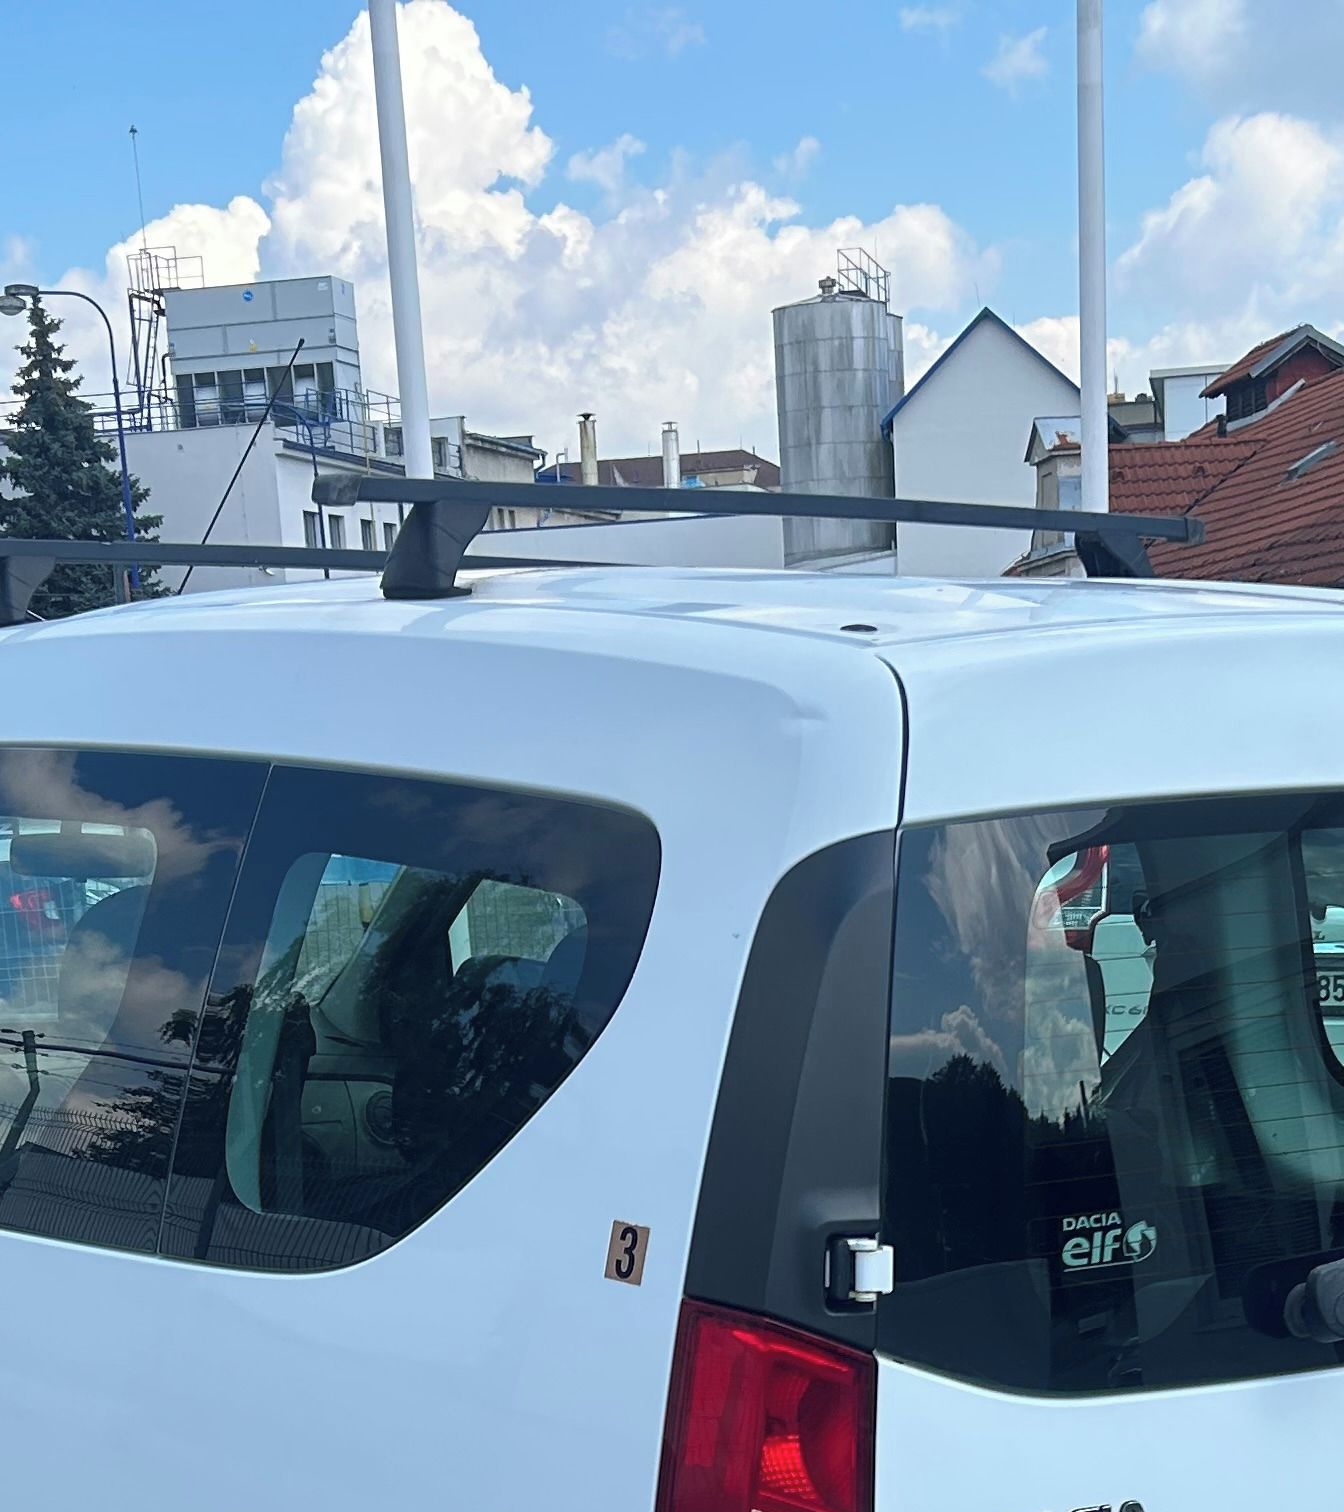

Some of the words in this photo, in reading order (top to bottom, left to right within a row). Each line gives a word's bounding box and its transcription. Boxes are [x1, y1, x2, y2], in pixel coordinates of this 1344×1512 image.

[1062, 1212, 1122, 1231] DACIA
[615, 1226, 639, 1279] 3
[1062, 1228, 1122, 1266] elf
